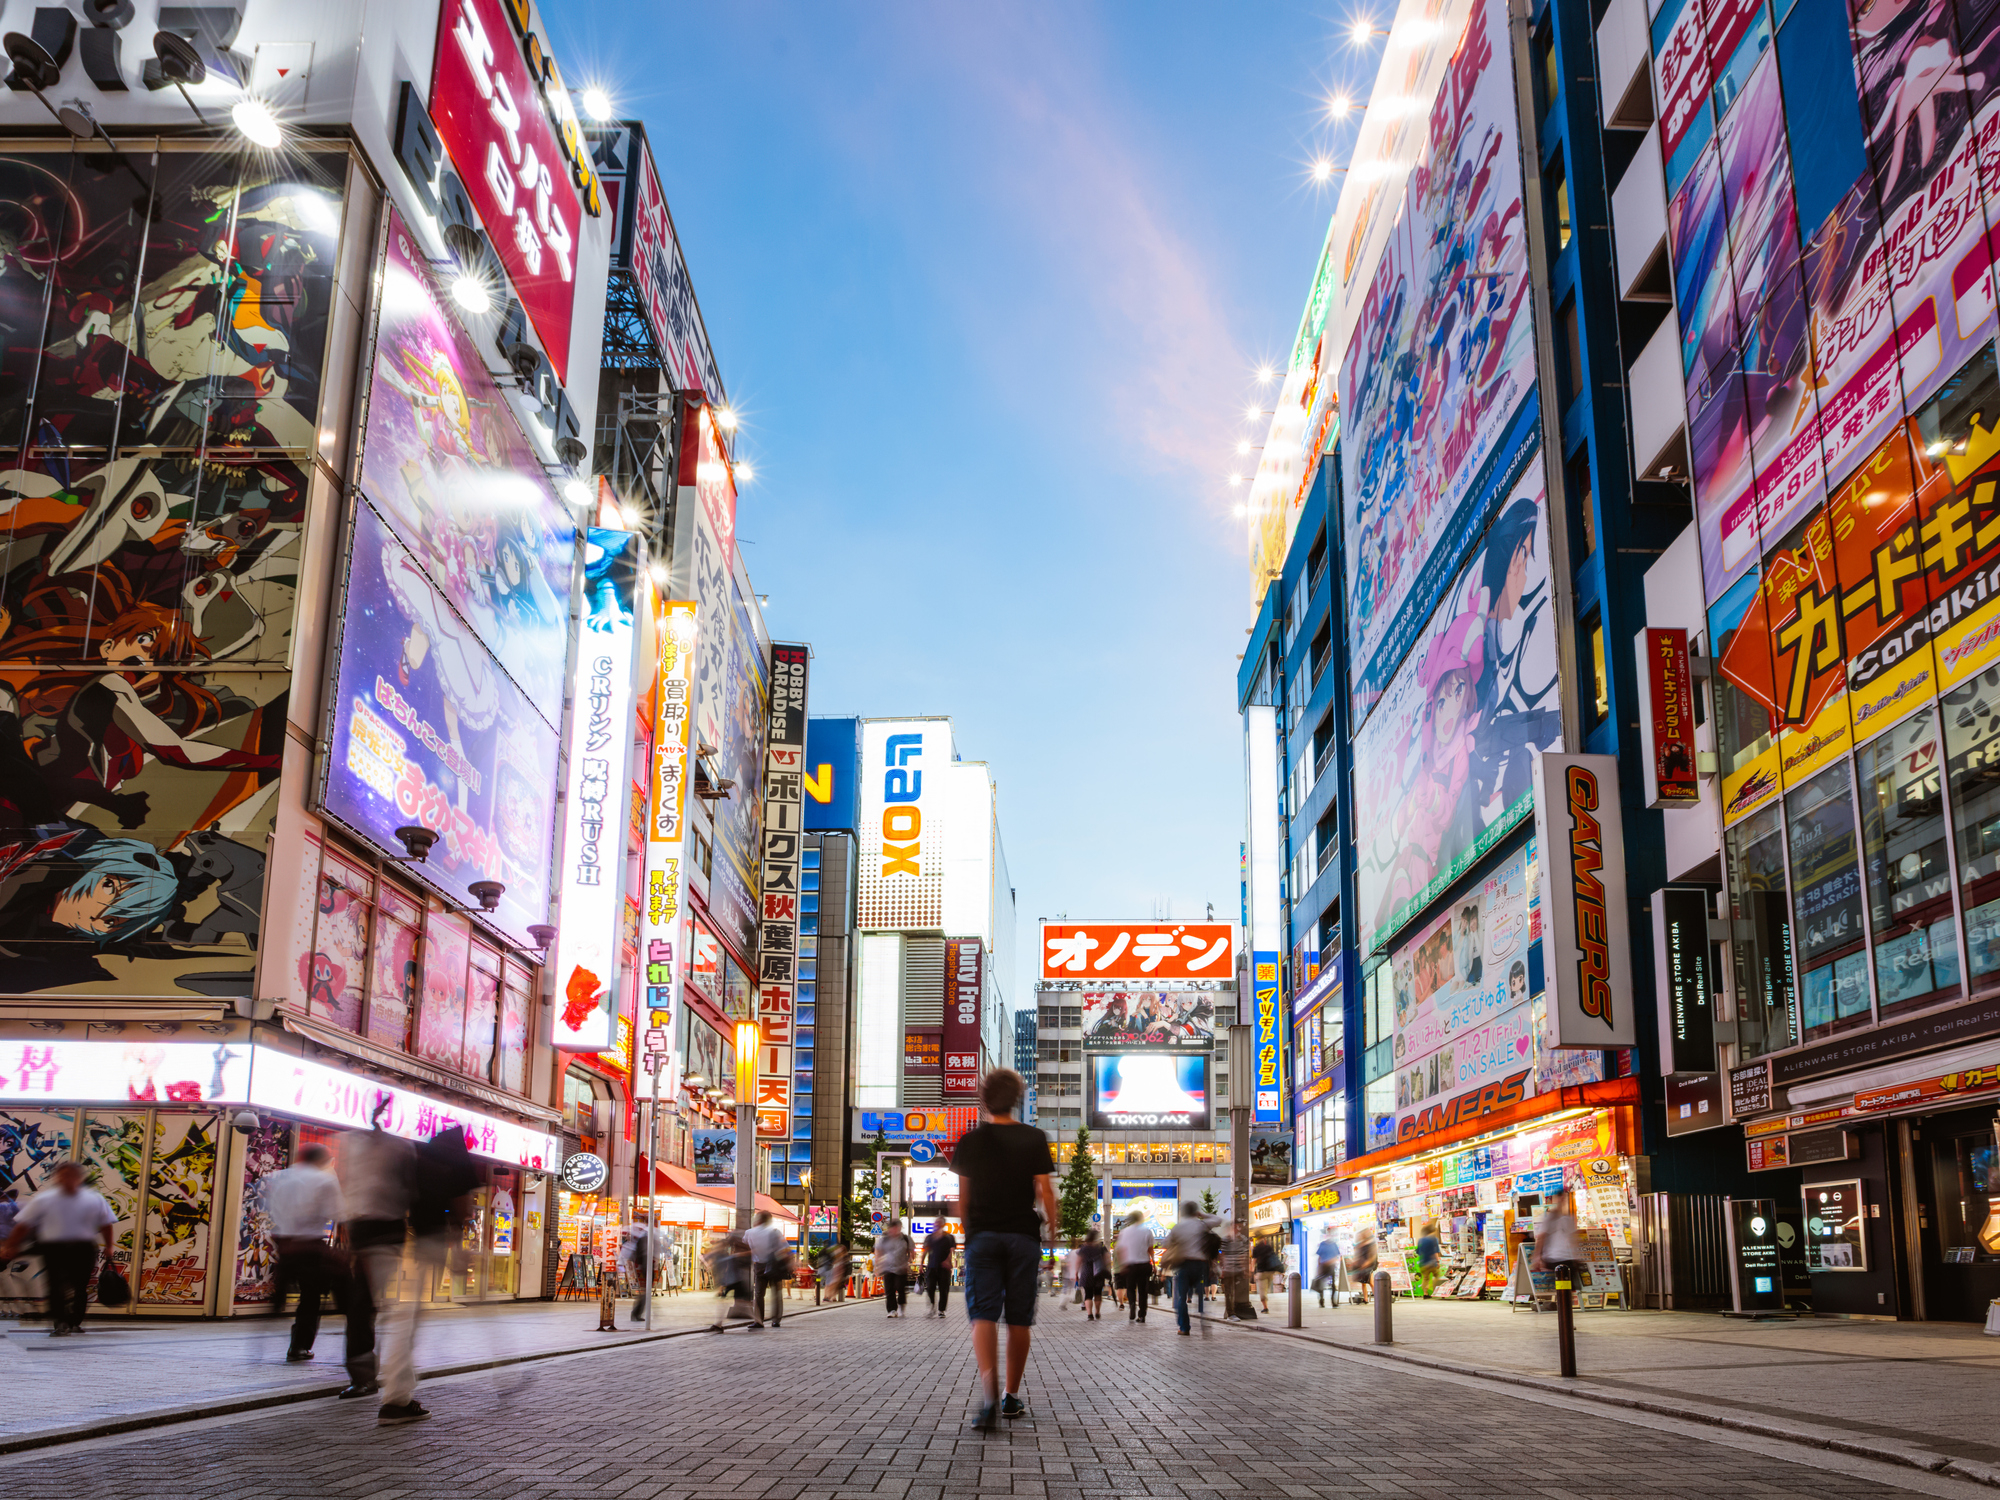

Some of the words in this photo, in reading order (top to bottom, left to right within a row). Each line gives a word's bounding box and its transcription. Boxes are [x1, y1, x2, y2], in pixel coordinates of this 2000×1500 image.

[770, 650, 790, 741] PARADISE
[788, 650, 806, 712] HOBBY
[1659, 646, 1681, 740] カードキングダム
[1566, 763, 1616, 1032] GAMERS
[1047, 925, 1229, 972] オノデン
[1671, 921, 1680, 951] AKIBA
[947, 943, 958, 979] Flagship
[957, 943, 980, 983] Duty
[1258, 964, 1276, 980] 薬
[1674, 952, 1682, 984] STORE
[948, 981, 957, 1006] Store
[957, 986, 979, 1024] Free
[1407, 981, 1507, 1056] あいみんとおざぴゅあ
[1677, 984, 1686, 1041] ALIENWARE
[1783, 1052, 1839, 1073] ALIENWARE
[1843, 1042, 1877, 1058] STORE
[1881, 1032, 1917, 1047] AKIBA
[1934, 1021, 1954, 1034] Dell
[1956, 1015, 1981, 1028] Real
[1983, 1010, 2000, 1021] Sit
[947, 1055, 976, 1068] 免税
[1459, 1063, 1477, 1082] ON
[1480, 1042, 1515, 1075] SALE
[1732, 1066, 1768, 1082] お部屋探し
[946, 1077, 976, 1088] 면세점
[1746, 1077, 1768, 1089] iDEAL
[1107, 1114, 1158, 1125] TOKYO
[1160, 1114, 1190, 1125] MX
[1397, 1067, 1533, 1144] GAMERS
[567, 1155, 602, 1172] SMOKER'S
[577, 1161, 593, 1170] Cafe
[1131, 1153, 1187, 1163] MODIFY
[606, 1235, 618, 1260] TAX
